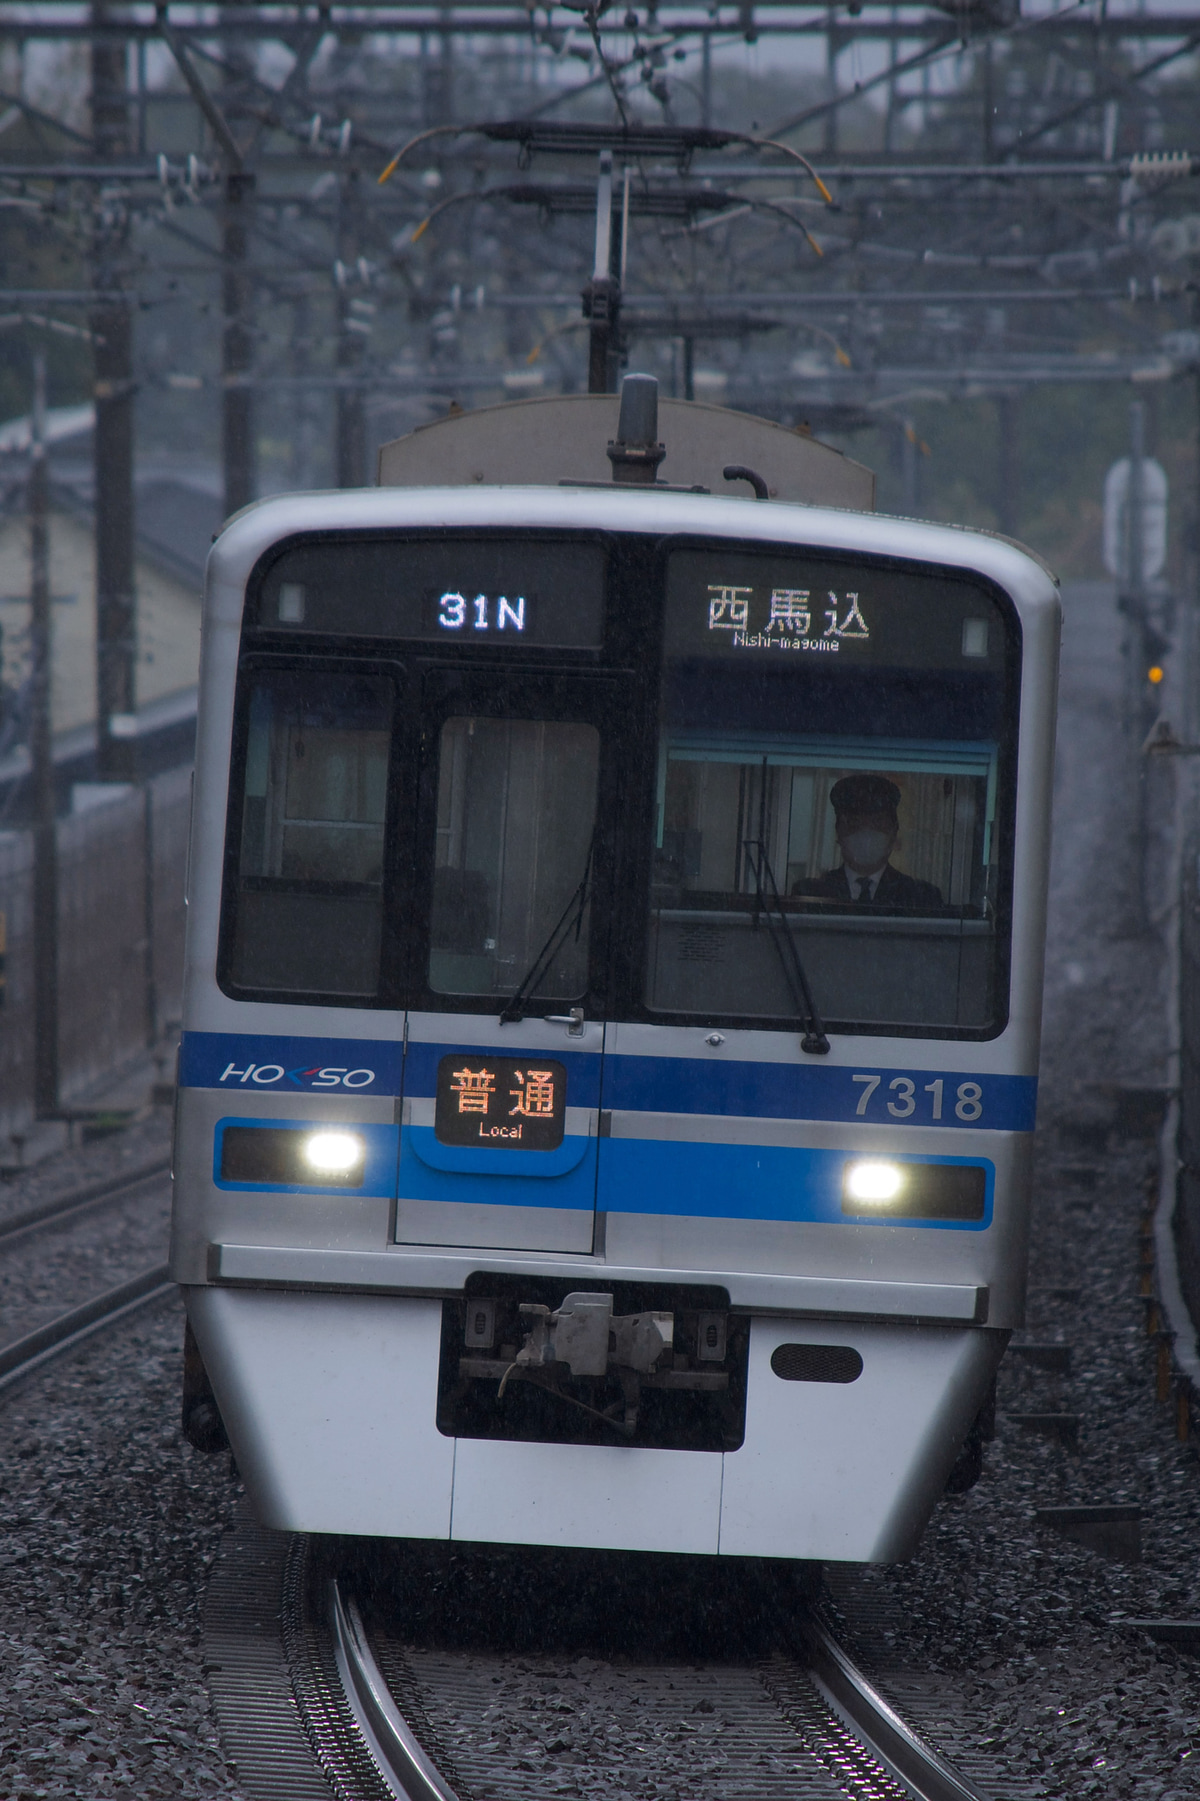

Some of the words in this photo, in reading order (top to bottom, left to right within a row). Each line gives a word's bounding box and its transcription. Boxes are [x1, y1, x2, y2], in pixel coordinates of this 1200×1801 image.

[438, 592, 526, 630] 31N
[707, 585, 870, 638] 西馬込
[733, 631, 841, 652] Nishi-magome
[450, 1067, 554, 1118] 普通
[852, 1074, 983, 1121] 7318
[479, 1121, 523, 1140] Local
